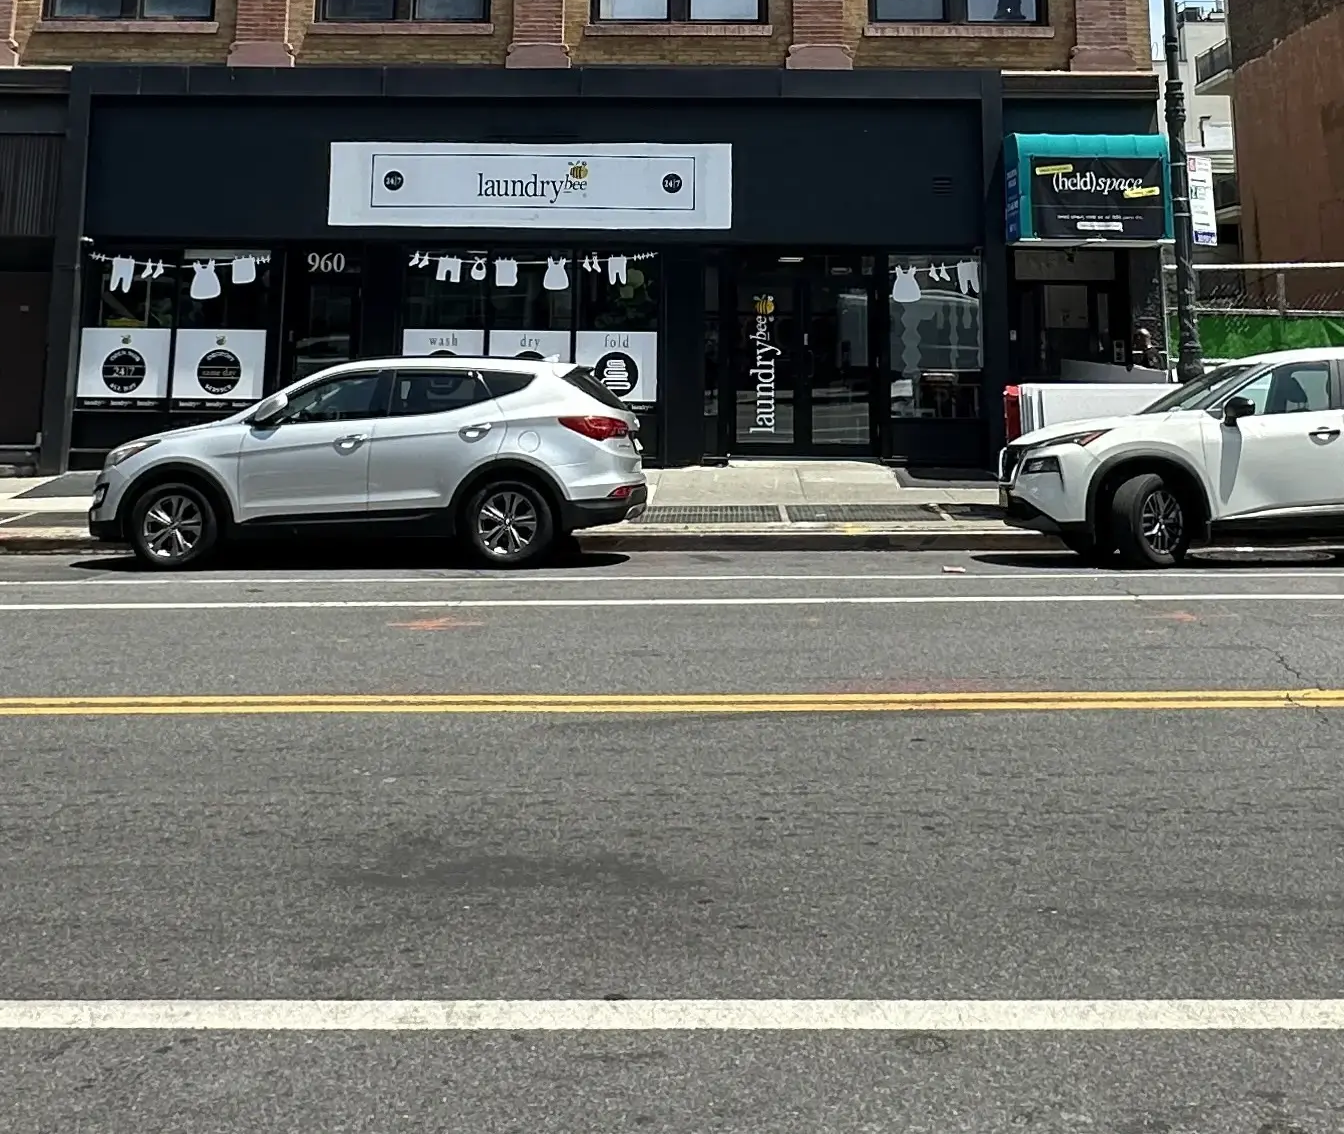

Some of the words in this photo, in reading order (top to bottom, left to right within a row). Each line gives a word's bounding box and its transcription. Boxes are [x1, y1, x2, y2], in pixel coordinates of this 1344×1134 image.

[307, 252, 346, 273] 960
[429, 333, 458, 347] wash
[519, 334, 541, 351] dry
[604, 334, 630, 348] fold
